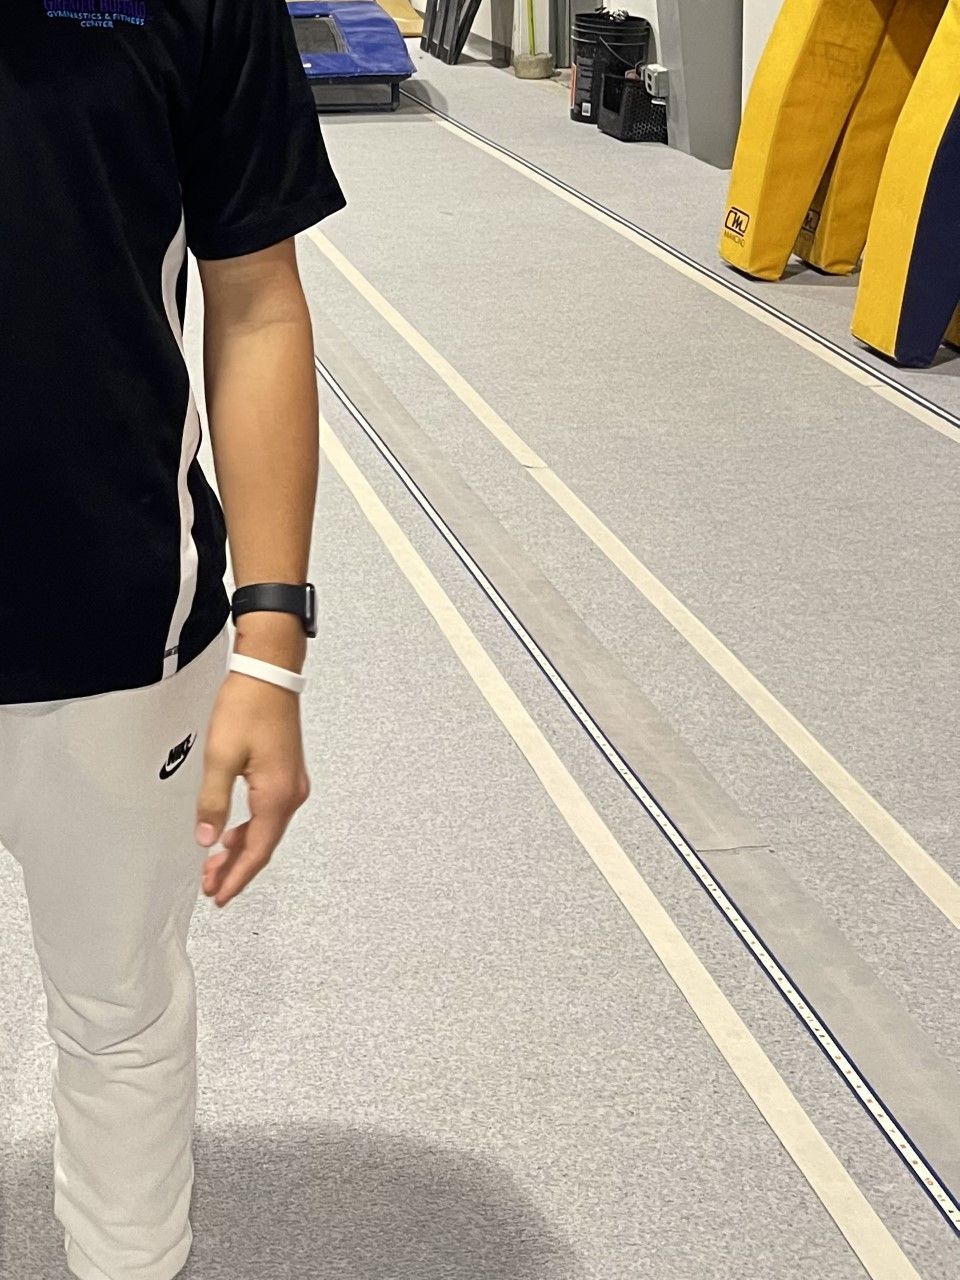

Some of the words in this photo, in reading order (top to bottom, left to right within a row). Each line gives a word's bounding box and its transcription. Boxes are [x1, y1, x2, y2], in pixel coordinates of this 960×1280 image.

[47, 10, 102, 20] GYMNASTICS
[112, 13, 145, 26] FITNESS
[80, 20, 114, 28] CENTER
